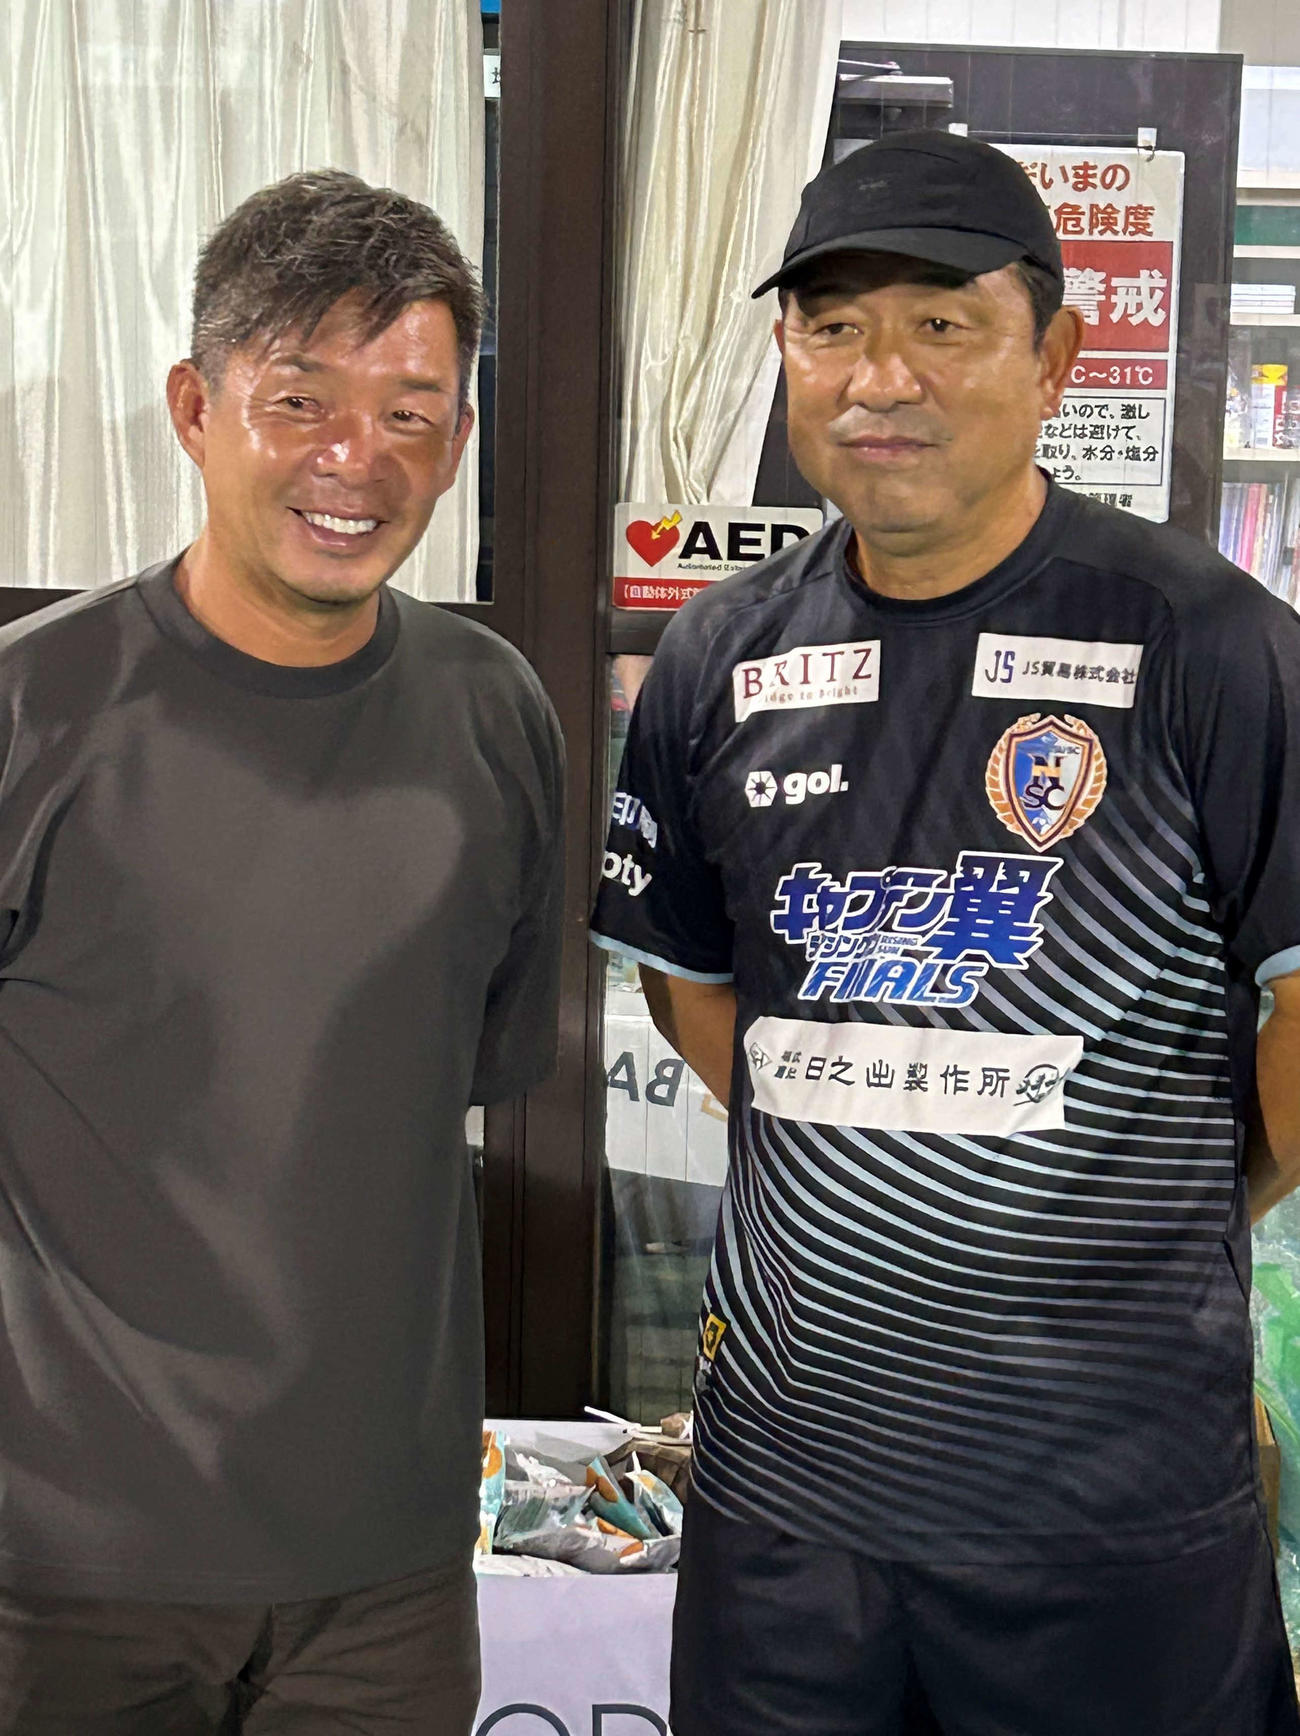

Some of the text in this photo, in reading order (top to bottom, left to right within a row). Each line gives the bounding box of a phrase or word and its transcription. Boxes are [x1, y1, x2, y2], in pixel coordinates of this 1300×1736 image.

[1048, 202, 1155, 237] 危険度
[1062, 267, 1167, 327] 警戒
[1039, 422, 1142, 441] などは避けて、
[984, 649, 1016, 684] JS
